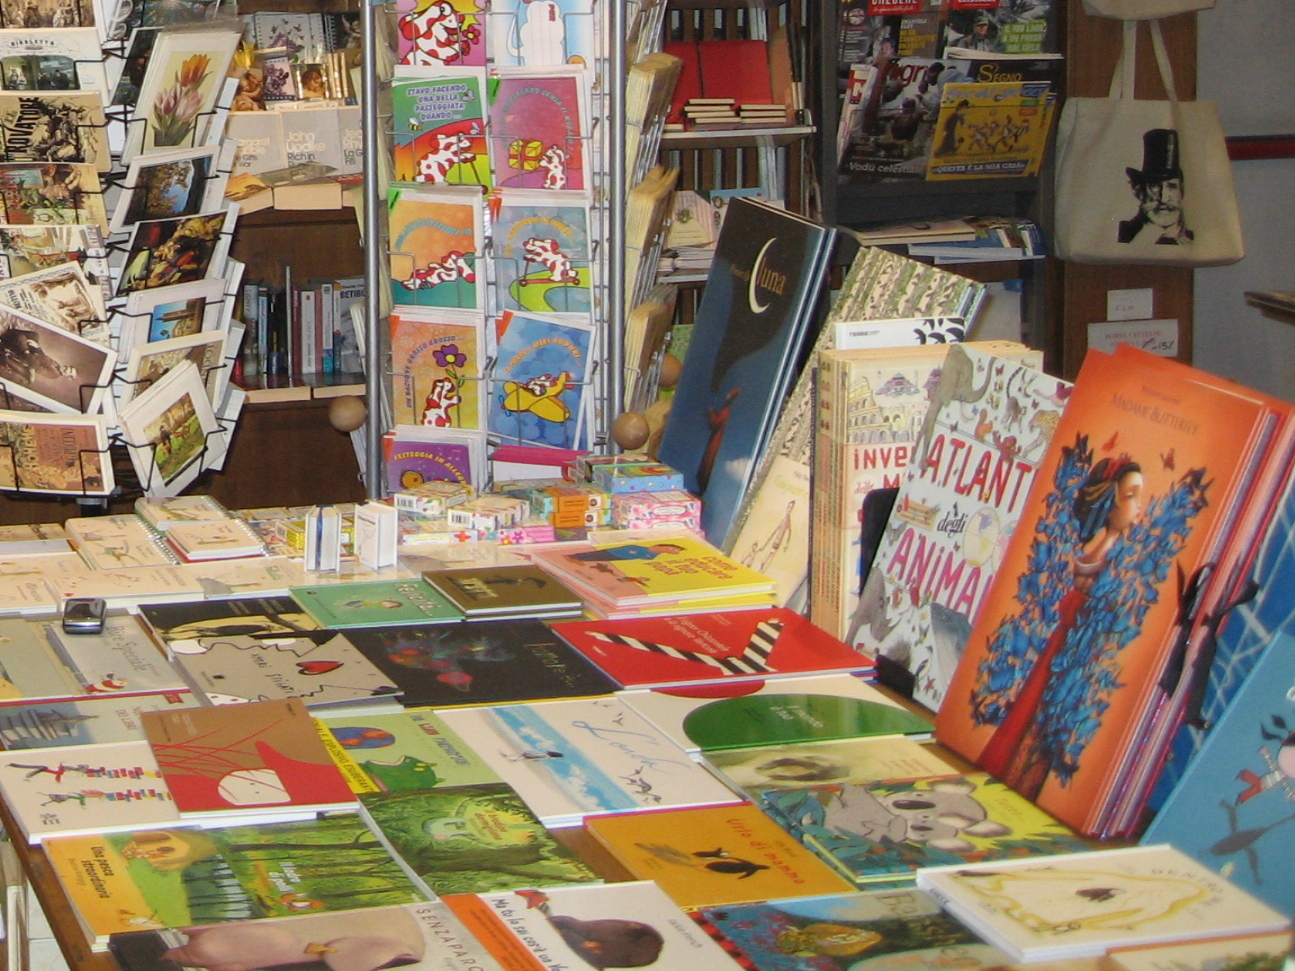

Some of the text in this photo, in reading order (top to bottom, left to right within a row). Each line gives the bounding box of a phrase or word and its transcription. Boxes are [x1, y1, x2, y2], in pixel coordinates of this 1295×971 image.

[406, 84, 467, 96] STAVO FACENDO
[418, 93, 458, 103] UNA BELLA
[415, 102, 464, 112] PASSEGGIATA
[421, 112, 452, 120] QUANDO
[937, 501, 967, 533] degli
[112, 641, 152, 671] Speciale
[768, 853, 806, 885] mamma
